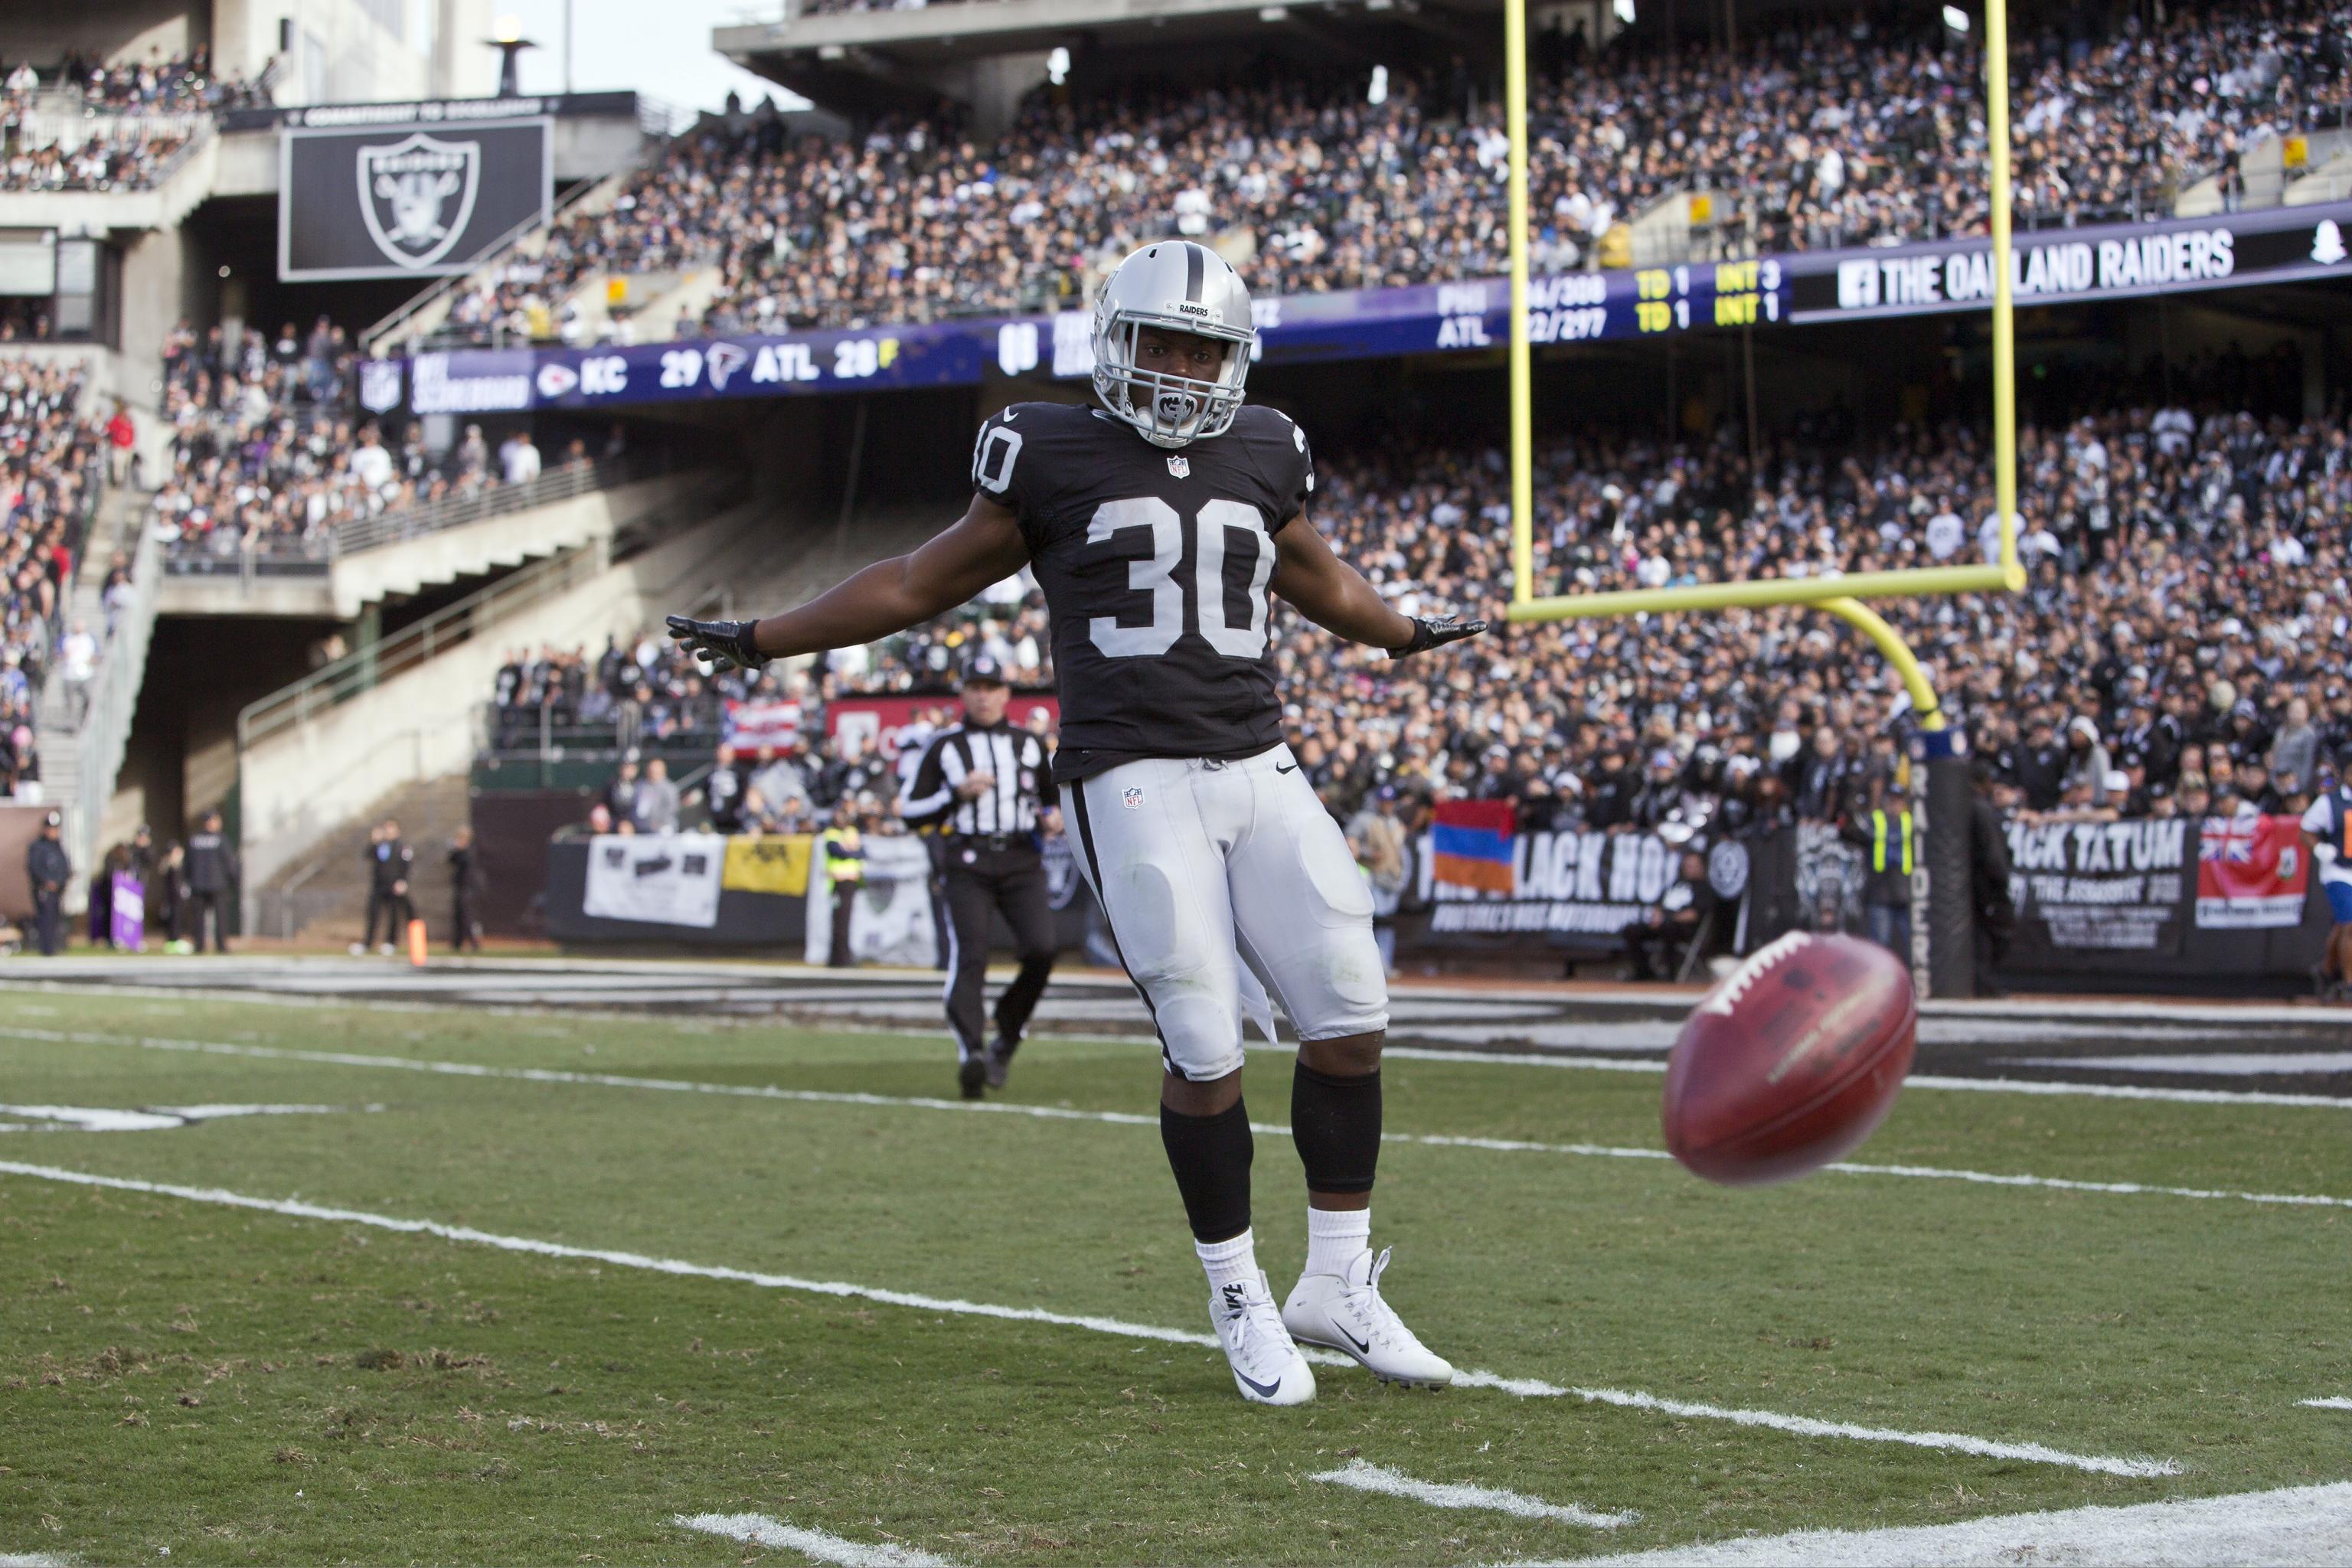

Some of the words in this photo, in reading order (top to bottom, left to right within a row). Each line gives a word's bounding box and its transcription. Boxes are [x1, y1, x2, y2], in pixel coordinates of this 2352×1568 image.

[1528, 274, 1607, 311] 6/308
[1635, 269, 1671, 300] TD
[1674, 265, 1690, 296] 1
[1714, 260, 1760, 294] INT
[1762, 259, 1782, 291] 3
[1881, 253, 1942, 306] THE
[2098, 228, 2235, 289] RAIDERS
[1179, 304, 1208, 317] RAIDERS
[1436, 314, 1491, 349] ATL
[1635, 300, 1671, 333] TD
[1674, 298, 1690, 330] 1
[1714, 292, 1760, 327] INT
[1762, 291, 1780, 323] 1
[580, 354, 628, 395] KC
[659, 348, 703, 388] 29
[750, 343, 822, 383] ATL
[833, 338, 878, 378] 28
[1086, 496, 1276, 659] 30
[1493, 831, 1606, 902] LACK
[2007, 821, 2071, 871] ACK
[2073, 818, 2187, 873] TATUM
[1910, 763, 1930, 1000] RAIDERS
